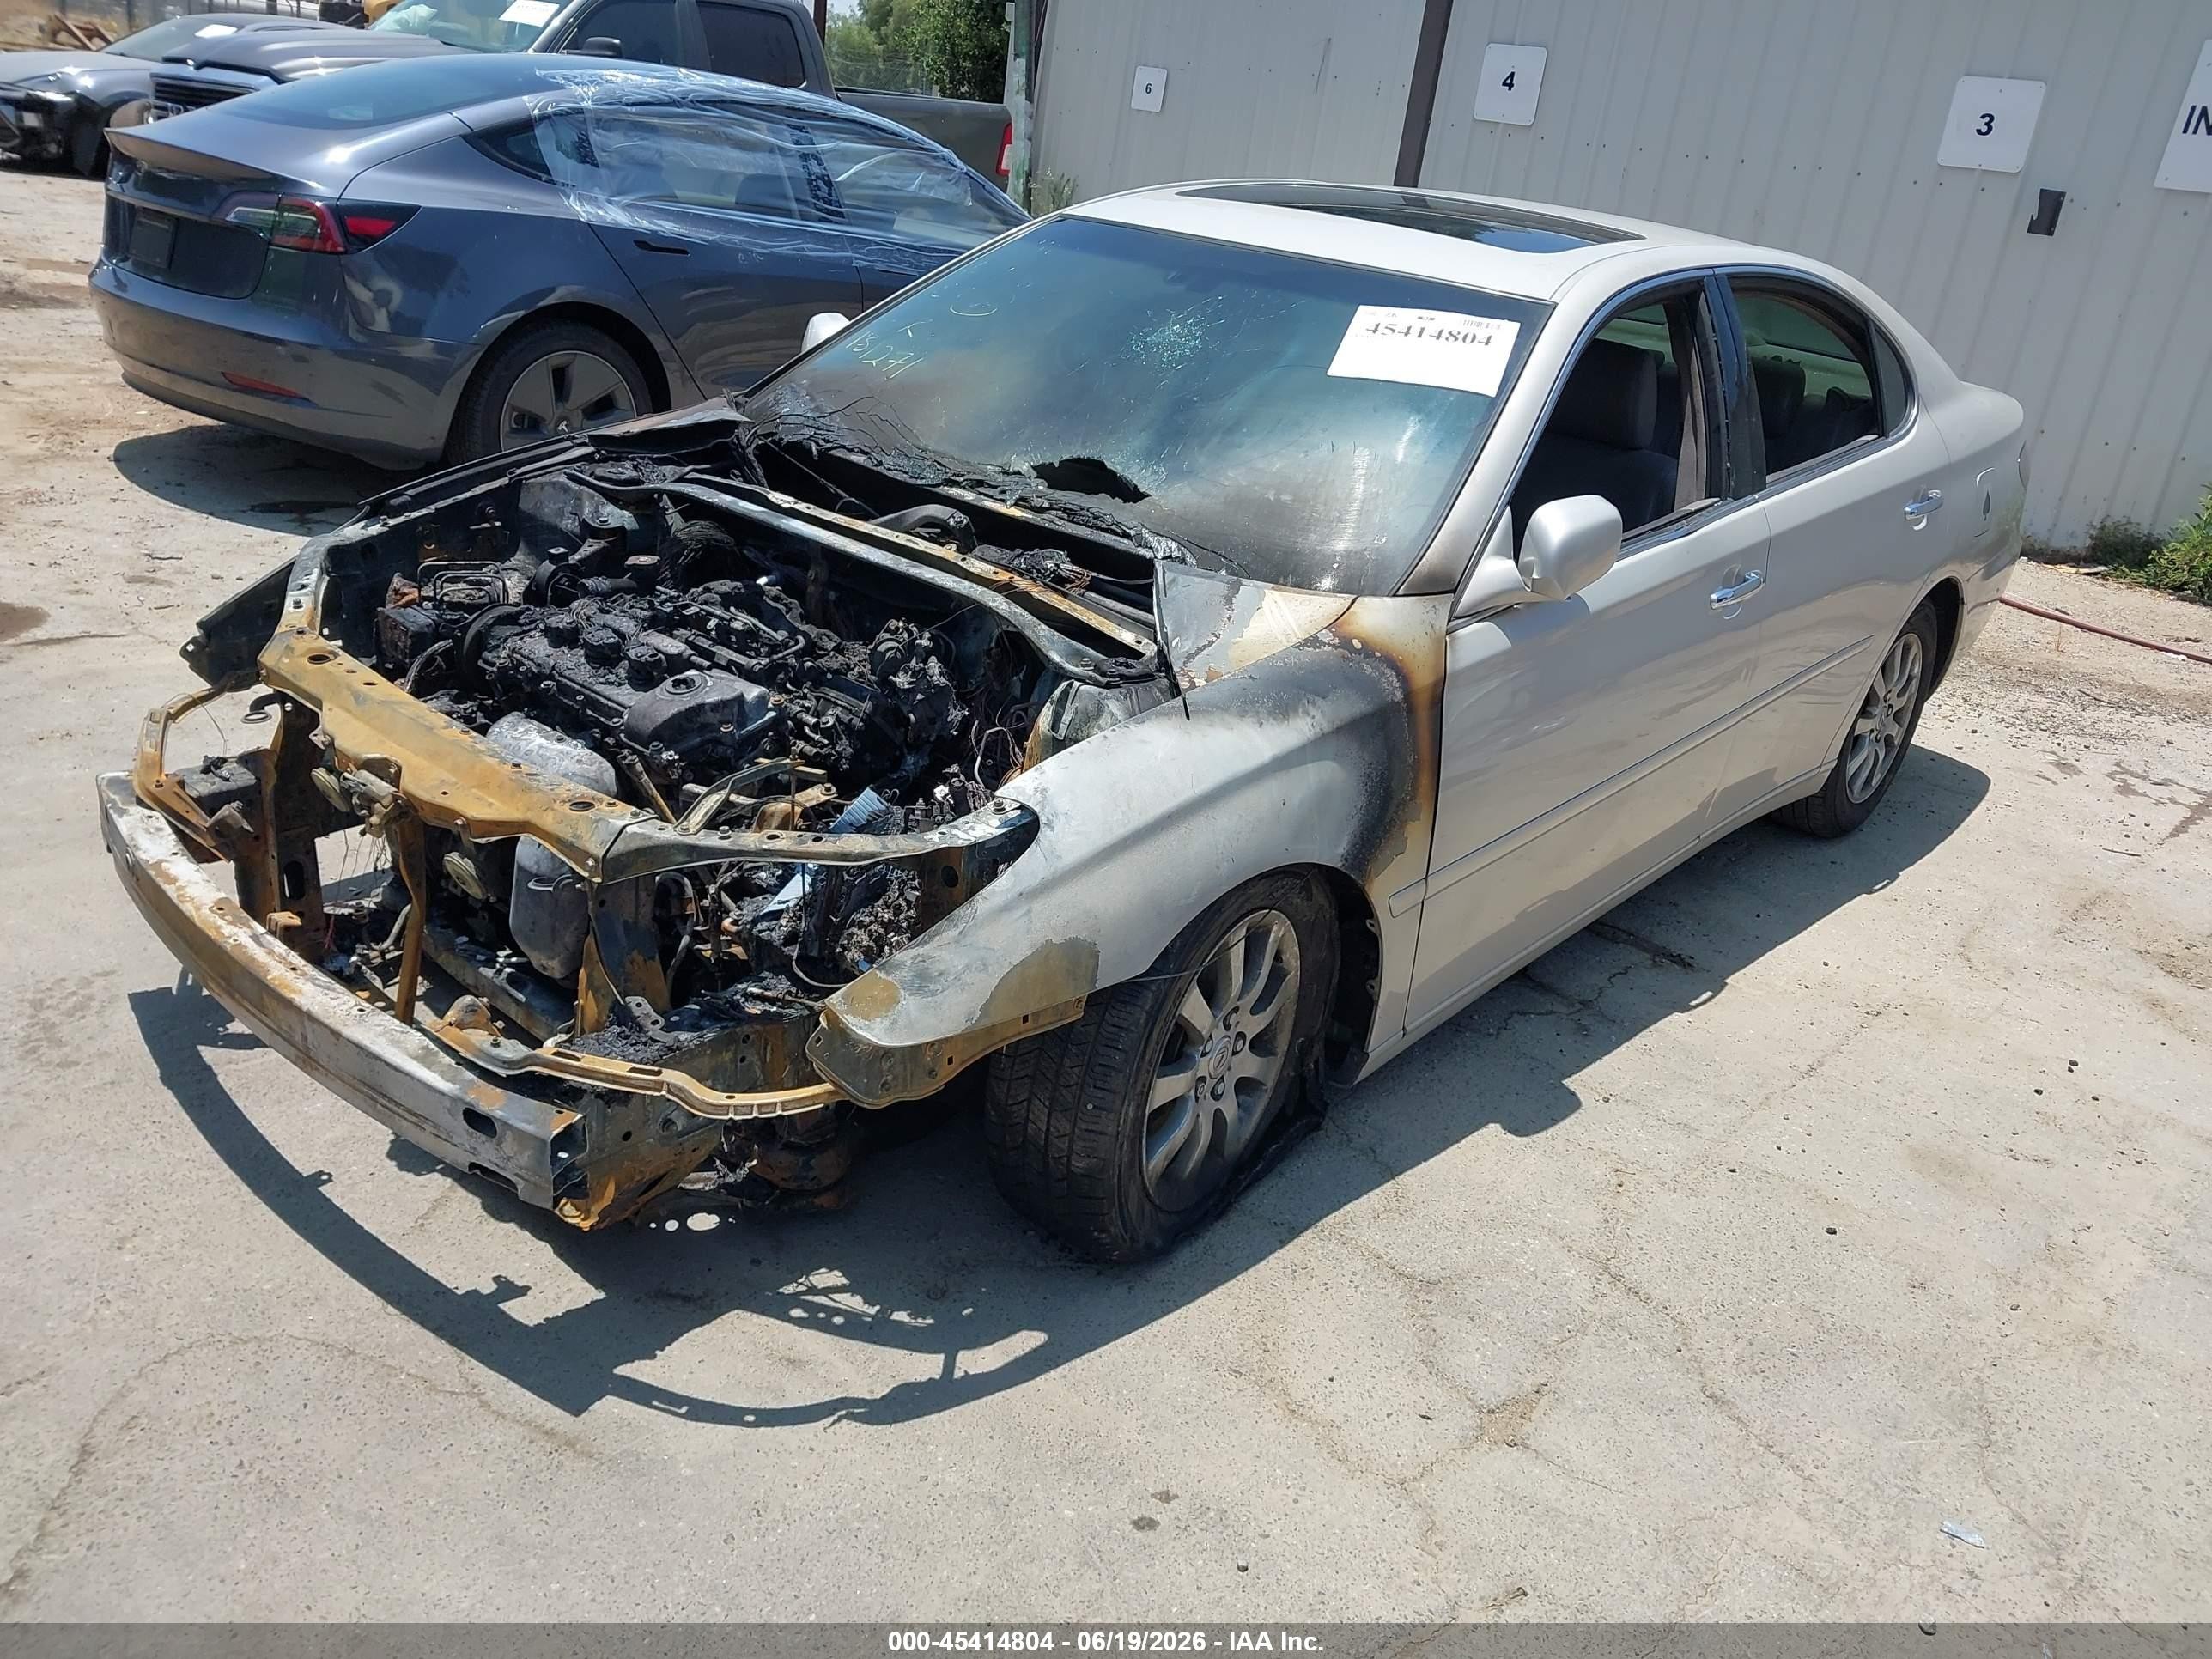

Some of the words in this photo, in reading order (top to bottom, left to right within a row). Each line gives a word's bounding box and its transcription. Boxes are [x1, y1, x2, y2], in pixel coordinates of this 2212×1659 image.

[1145, 82, 1152, 94] 6
[1501, 71, 1516, 91] 4
[1976, 112, 1995, 137] 3
[1365, 322, 1493, 346] 45414804
